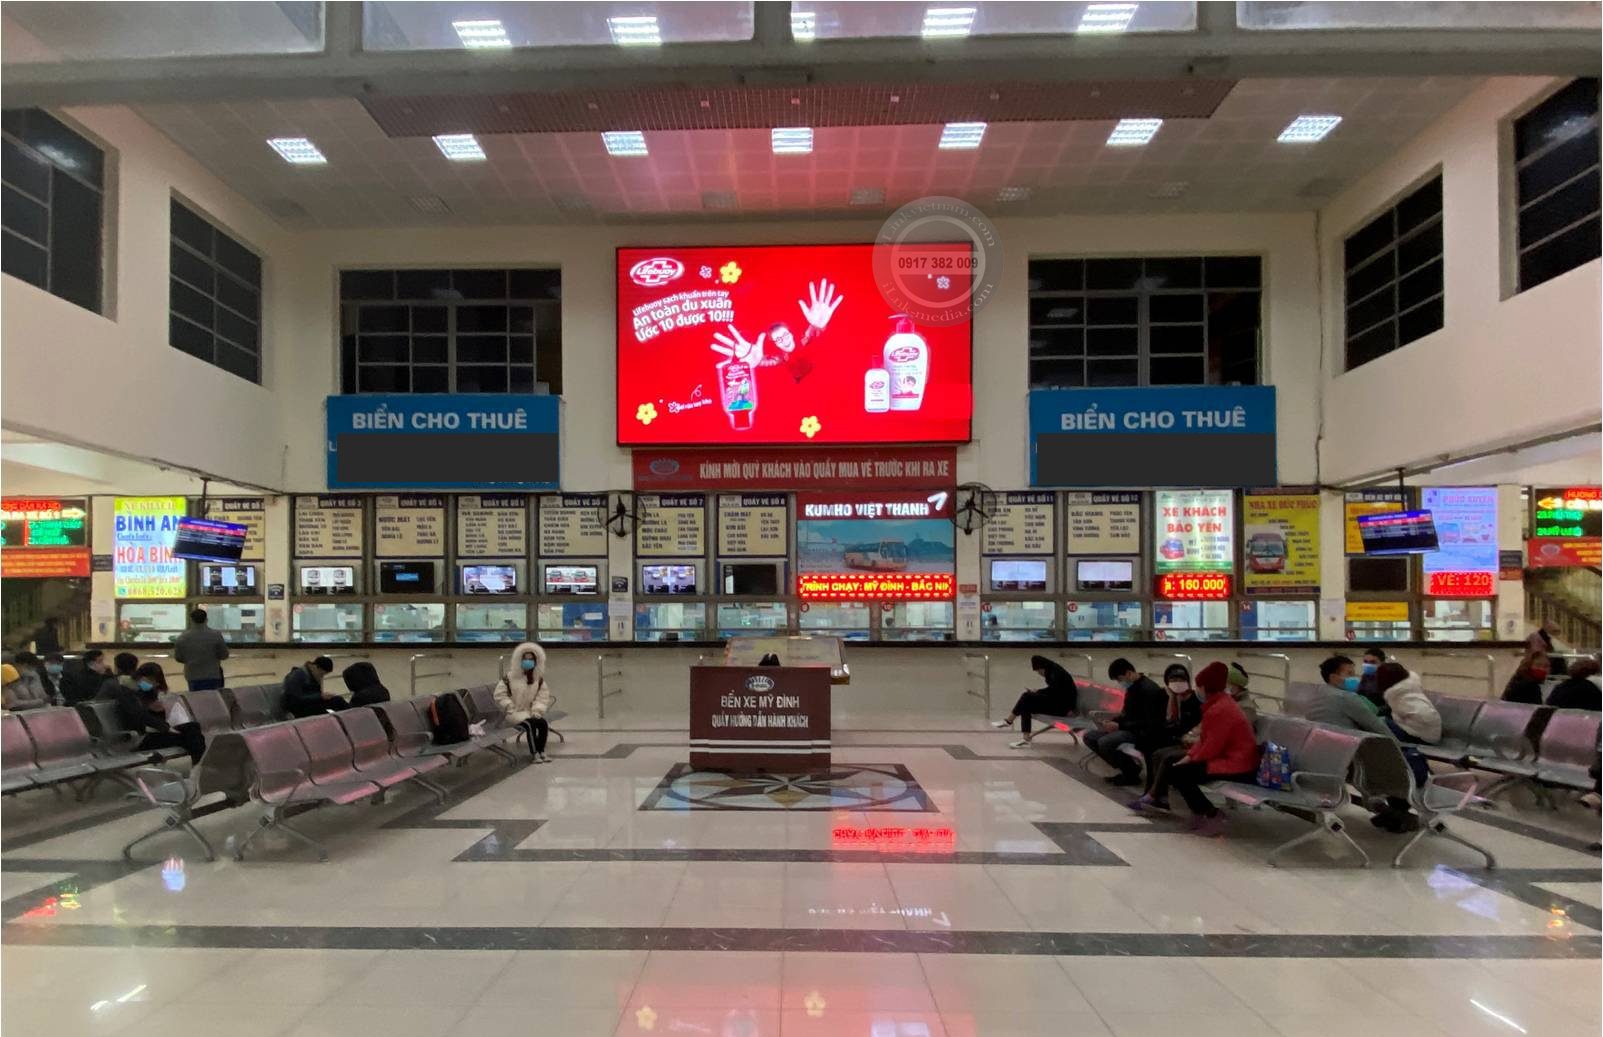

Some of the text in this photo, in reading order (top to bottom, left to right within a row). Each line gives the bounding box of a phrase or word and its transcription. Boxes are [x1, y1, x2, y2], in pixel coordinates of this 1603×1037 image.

[633, 296, 733, 331] An toàn du xuân
[659, 317, 675, 333] 10
[675, 313, 707, 327] được
[352, 403, 528, 430] BIỂN CHO THUÊ
[1061, 402, 1246, 430] BIỂN CHO THUÊ
[700, 460, 721, 479] KÍNH
[723, 459, 740, 479] MỜI
[742, 459, 760, 480] QUÝ
[762, 460, 791, 479] KHÁCH
[793, 459, 811, 478] VÀO
[838, 462, 859, 478] MUA
[861, 458, 872, 477] VÉ
[874, 458, 903, 477] TRƯỚC
[905, 460, 920, 477] KHI
[922, 461, 935, 477] RA
[937, 460, 949, 476] XE
[805, 503, 929, 519] KUMHO VIỆT THANH
[1162, 504, 1227, 518] XE KHÁCH
[116, 511, 156, 532] BÌNH
[1167, 519, 1193, 533] BẢO
[117, 541, 183, 564] HÒA BÌN
[832, 582, 862, 593] CHẠY:
[863, 579, 878, 592] MỸ
[880, 580, 904, 592] ĐÌNH
[911, 578, 933, 592] BẮC
[1179, 578, 1224, 591] 160.000
[720, 689, 800, 708] BẾN XE MỸ ĐÌNH
[729, 711, 752, 728] HƯỚNG
[768, 712, 786, 728] HÀNH
[787, 712, 809, 728] KHÁCH
